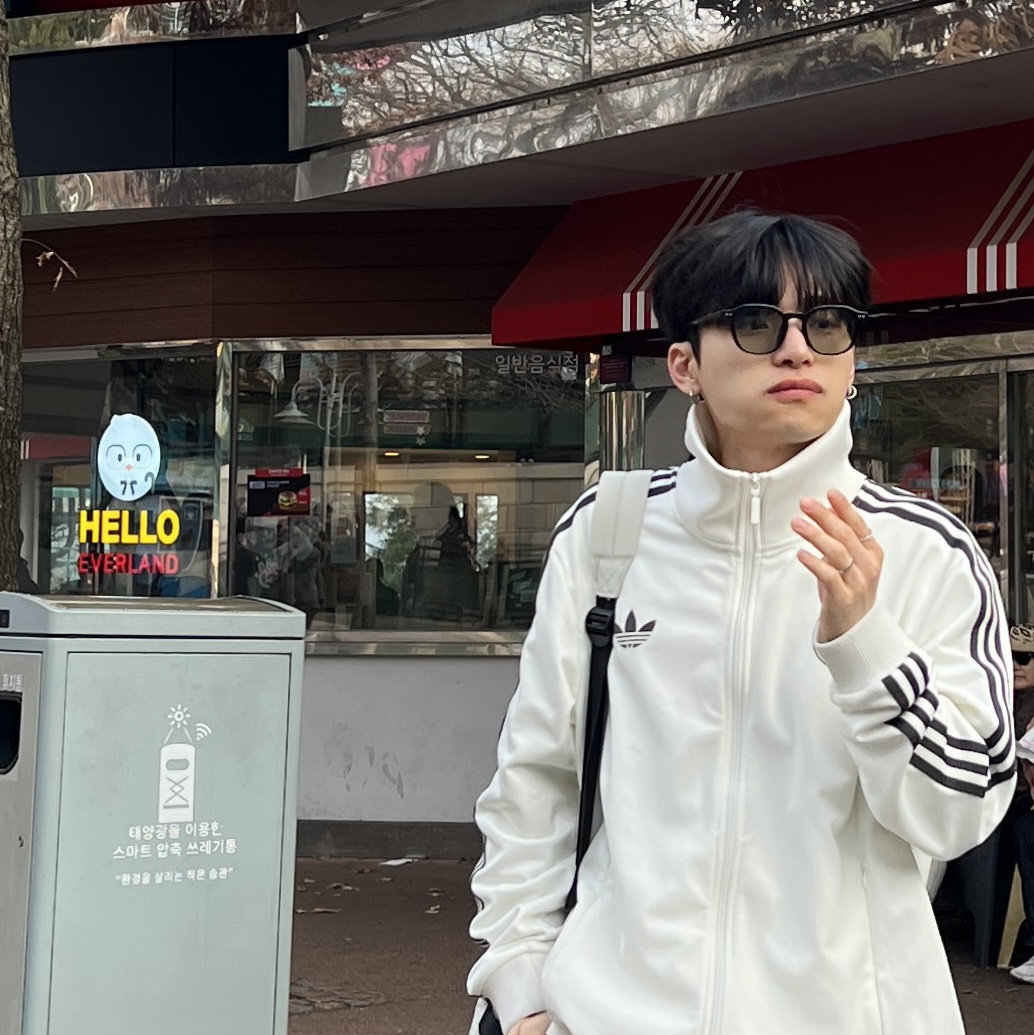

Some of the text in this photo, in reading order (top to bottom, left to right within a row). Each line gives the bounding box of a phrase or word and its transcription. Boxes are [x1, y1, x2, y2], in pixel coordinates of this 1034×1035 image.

[495, 352, 579, 375] 일반음식점
[79, 509, 180, 545] HELLO
[78, 553, 179, 575] EVERLAND
[128, 820, 224, 841] 태양광을 이용한
[112, 838, 237, 859] 스마트 압축 쓰레기통
